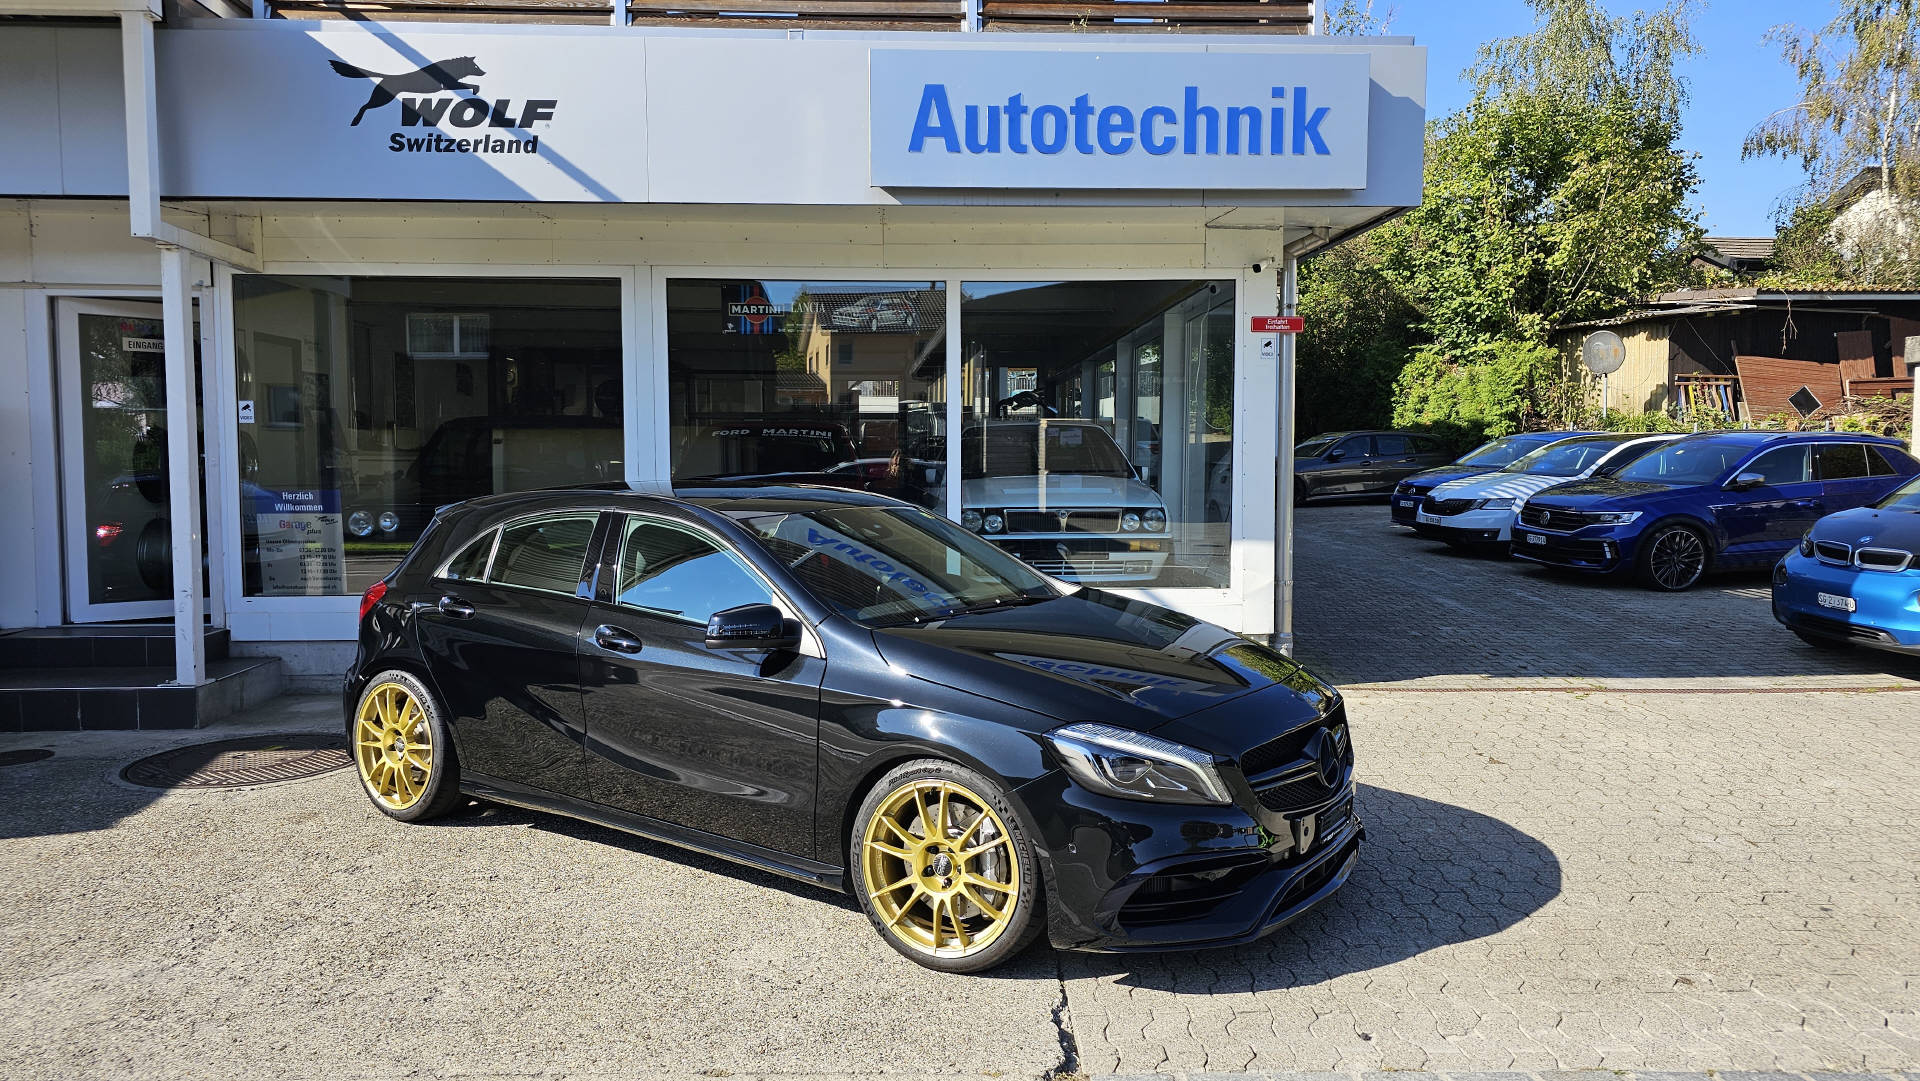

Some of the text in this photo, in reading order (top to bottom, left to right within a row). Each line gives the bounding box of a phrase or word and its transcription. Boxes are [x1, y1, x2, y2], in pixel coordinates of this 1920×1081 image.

[401, 97, 558, 129] WOLF
[908, 83, 1331, 155] Autotechnik
[388, 132, 539, 154] Switzerland
[731, 304, 781, 314] MARTINI
[791, 302, 826, 313] LANCIA
[128, 340, 164, 350] EINGANG
[712, 428, 750, 437] FORD
[762, 428, 832, 437] MARTINI
[282, 491, 314, 500] Herzlich
[274, 503, 323, 512] Willkommen
[279, 519, 312, 532] Garage
[306, 527, 322, 536] plus
[1013, 829, 1032, 885] MICHELIN
